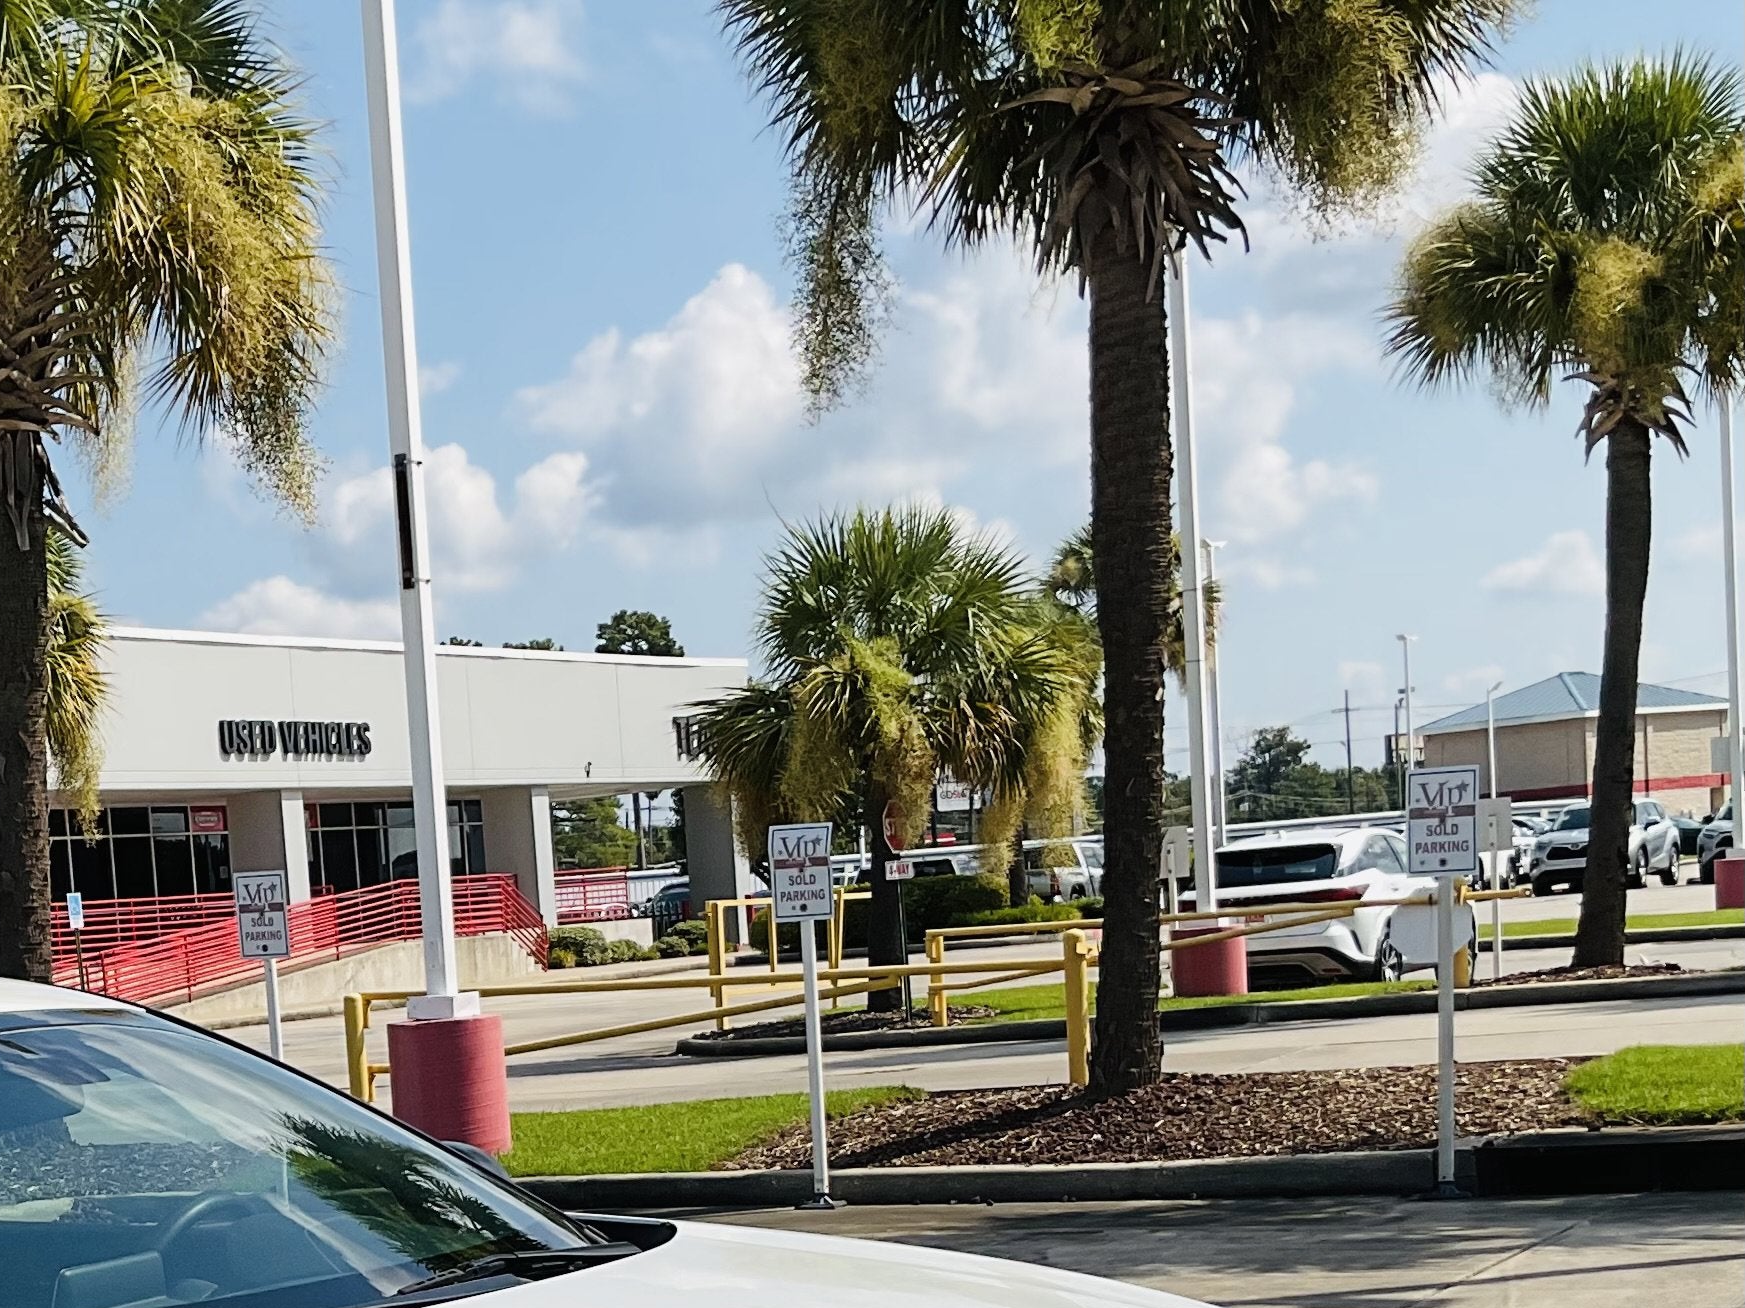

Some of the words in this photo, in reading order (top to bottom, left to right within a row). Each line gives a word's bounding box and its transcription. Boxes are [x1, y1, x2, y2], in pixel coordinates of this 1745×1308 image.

[218, 720, 276, 754] USED
[277, 721, 371, 754] VEHICLES
[1426, 823, 1459, 836] SOLD
[1415, 840, 1470, 854] PARKING
[788, 874, 816, 886] SOLD
[780, 889, 826, 902] PARKING
[251, 917, 274, 927] SOLD
[245, 930, 283, 941] PARKING
